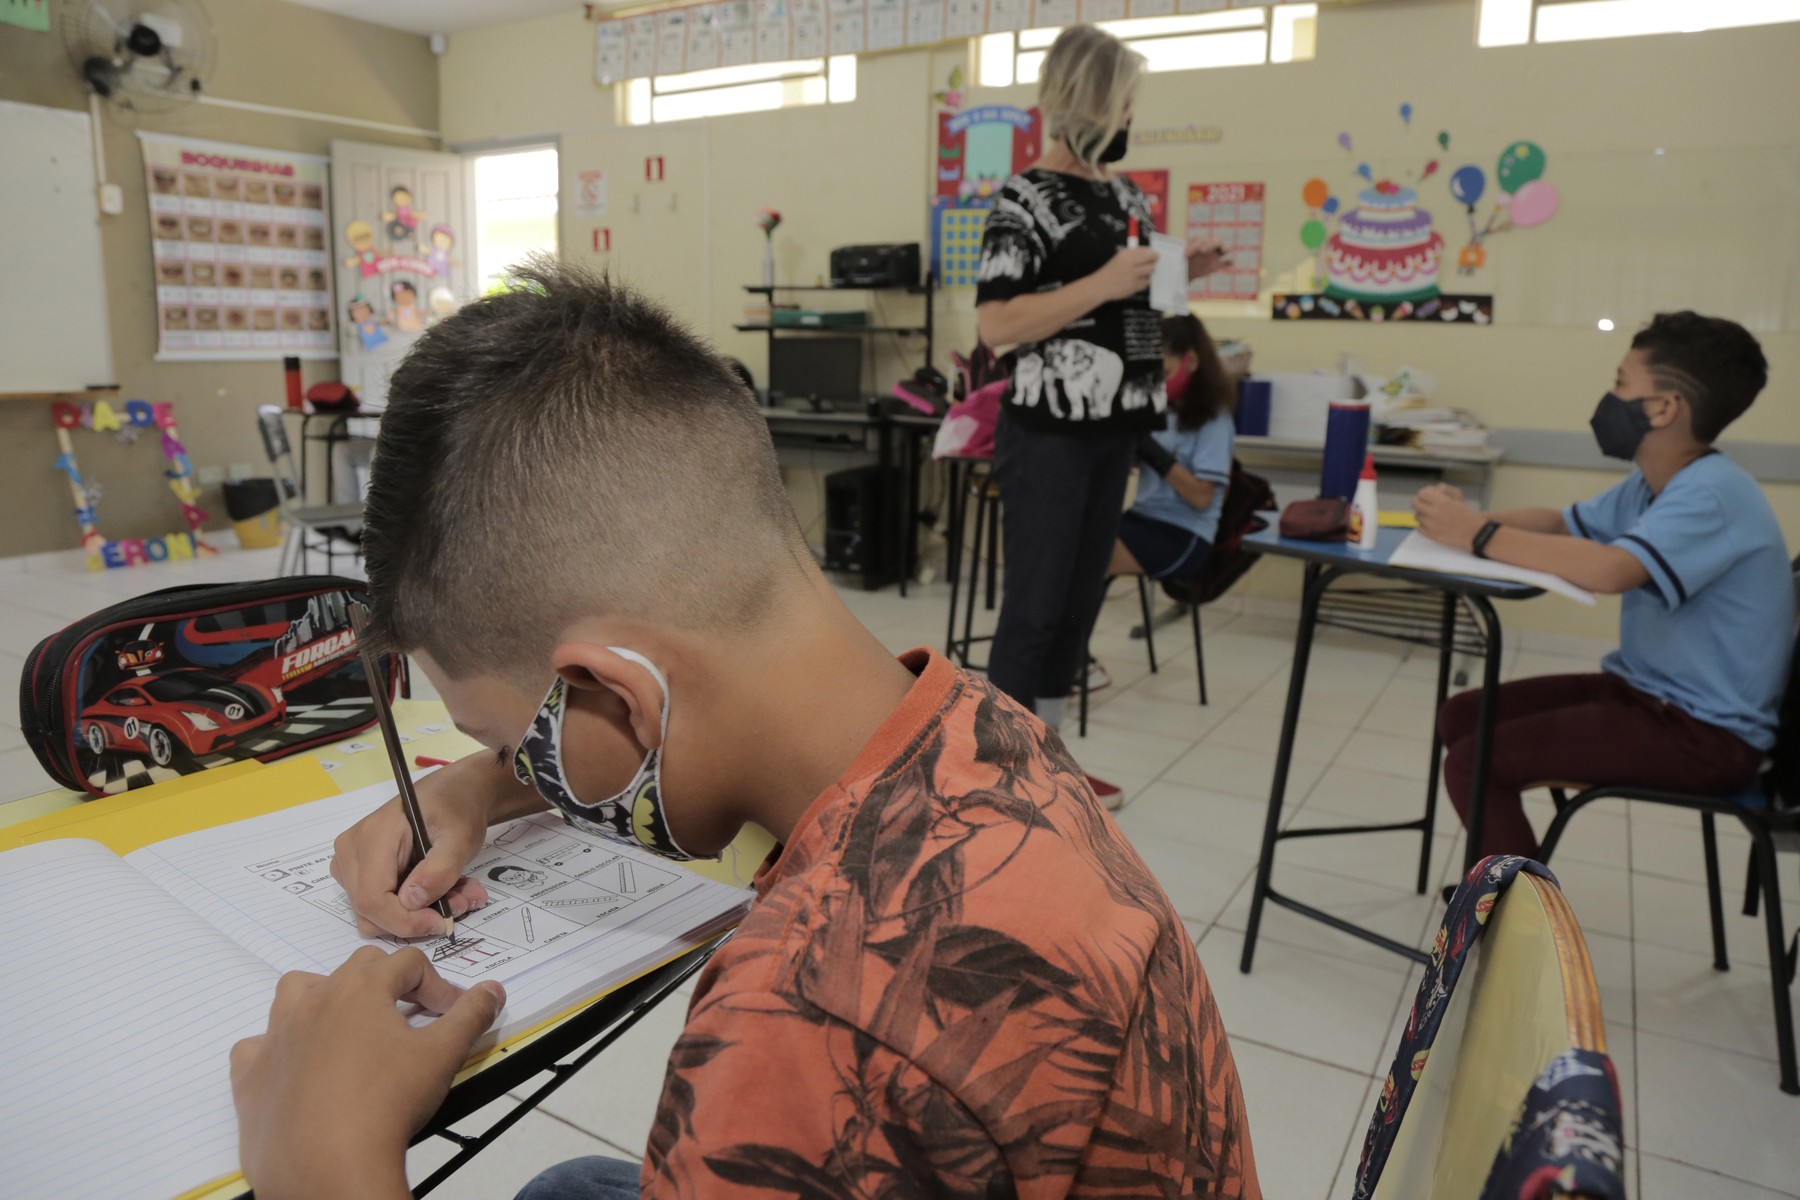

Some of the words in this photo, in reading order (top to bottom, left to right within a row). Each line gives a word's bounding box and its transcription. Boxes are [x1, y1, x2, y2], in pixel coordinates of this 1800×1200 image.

[1207, 184, 1245, 203] 2021
[52, 401, 120, 431] DIA
[126, 400, 178, 428] DE
[228, 706, 242, 718] 01
[126, 718, 138, 738] 01
[311, 874, 333, 884] CIRC
[530, 880, 568, 898] PROFESSORA
[483, 907, 510, 921] ESTANTE
[596, 906, 620, 919] ESCADA
[544, 931, 568, 944] CANETA
[485, 956, 513, 969] ESCOLA
